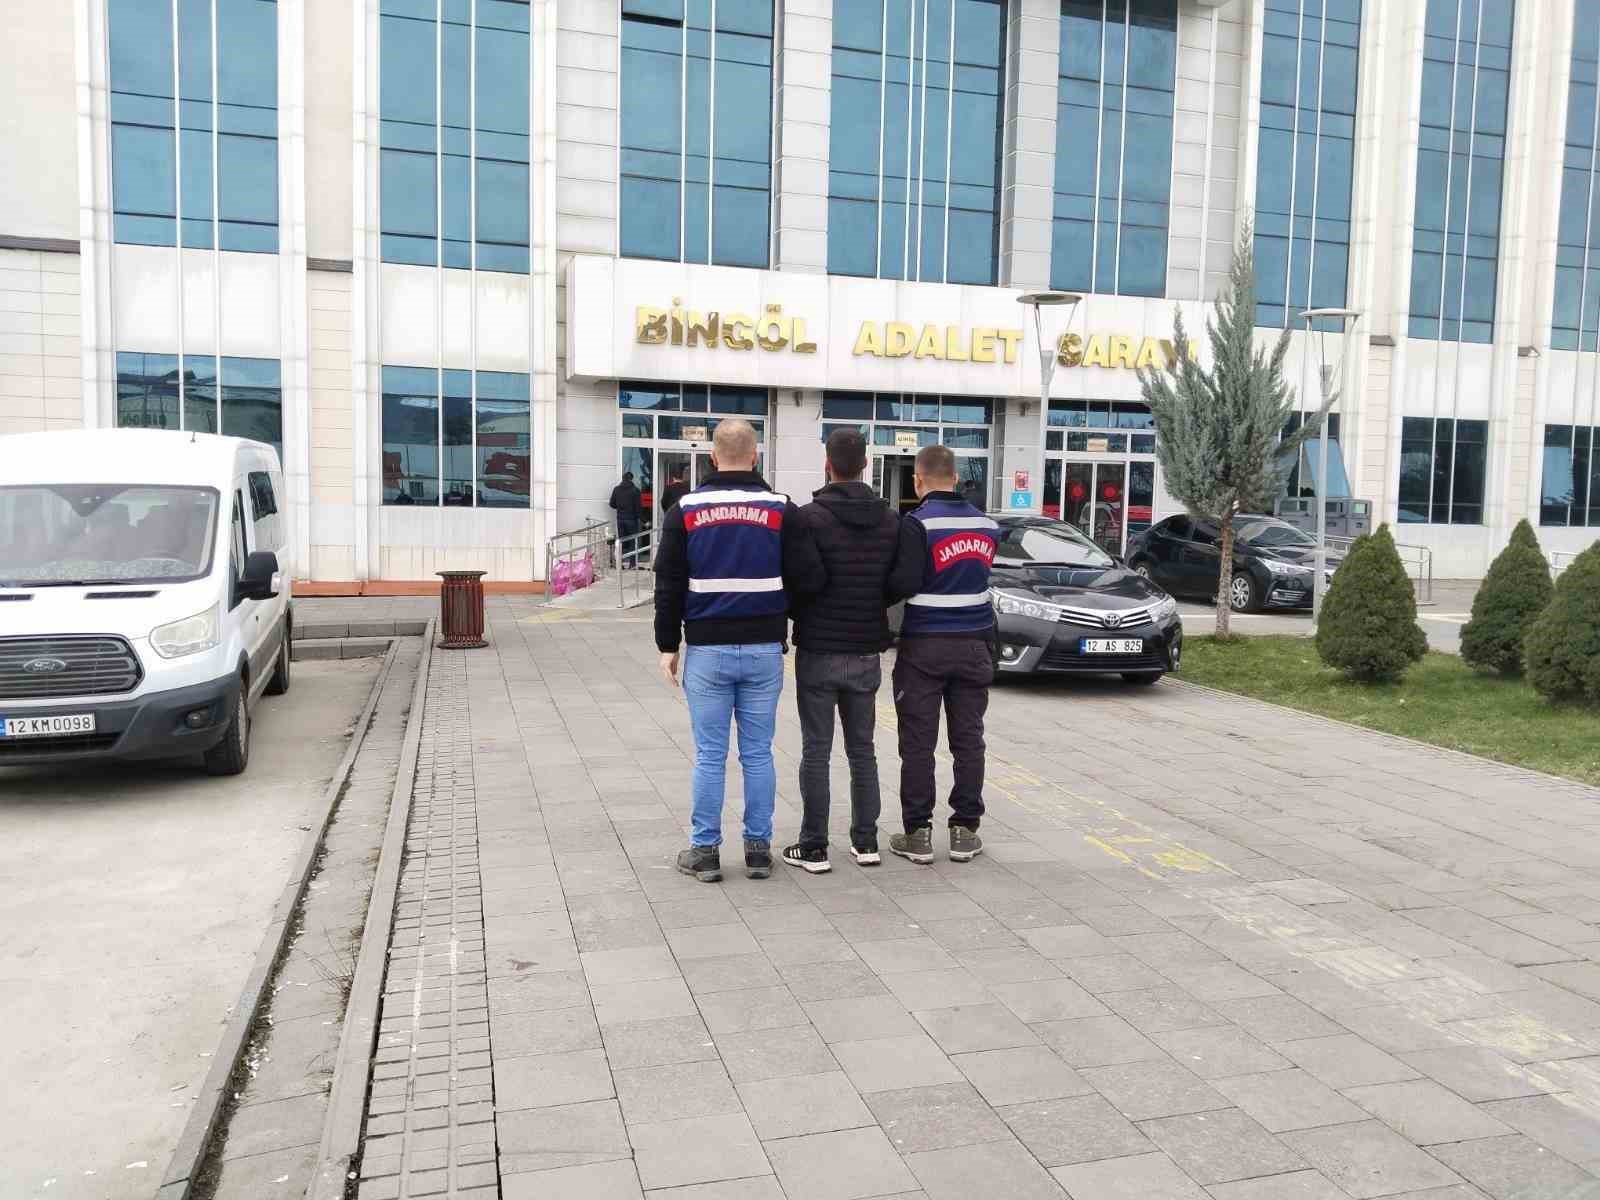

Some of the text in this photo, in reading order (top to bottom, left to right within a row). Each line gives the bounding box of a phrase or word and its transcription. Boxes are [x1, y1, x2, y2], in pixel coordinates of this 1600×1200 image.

[636, 296, 817, 353] BİNGÖL
[852, 321, 1025, 364] ADALET
[694, 506, 769, 526] JANDARMA
[939, 539, 993, 562] JANDARMA
[1087, 641, 1141, 652] 12 AS 825
[9, 720, 26, 733] 12
